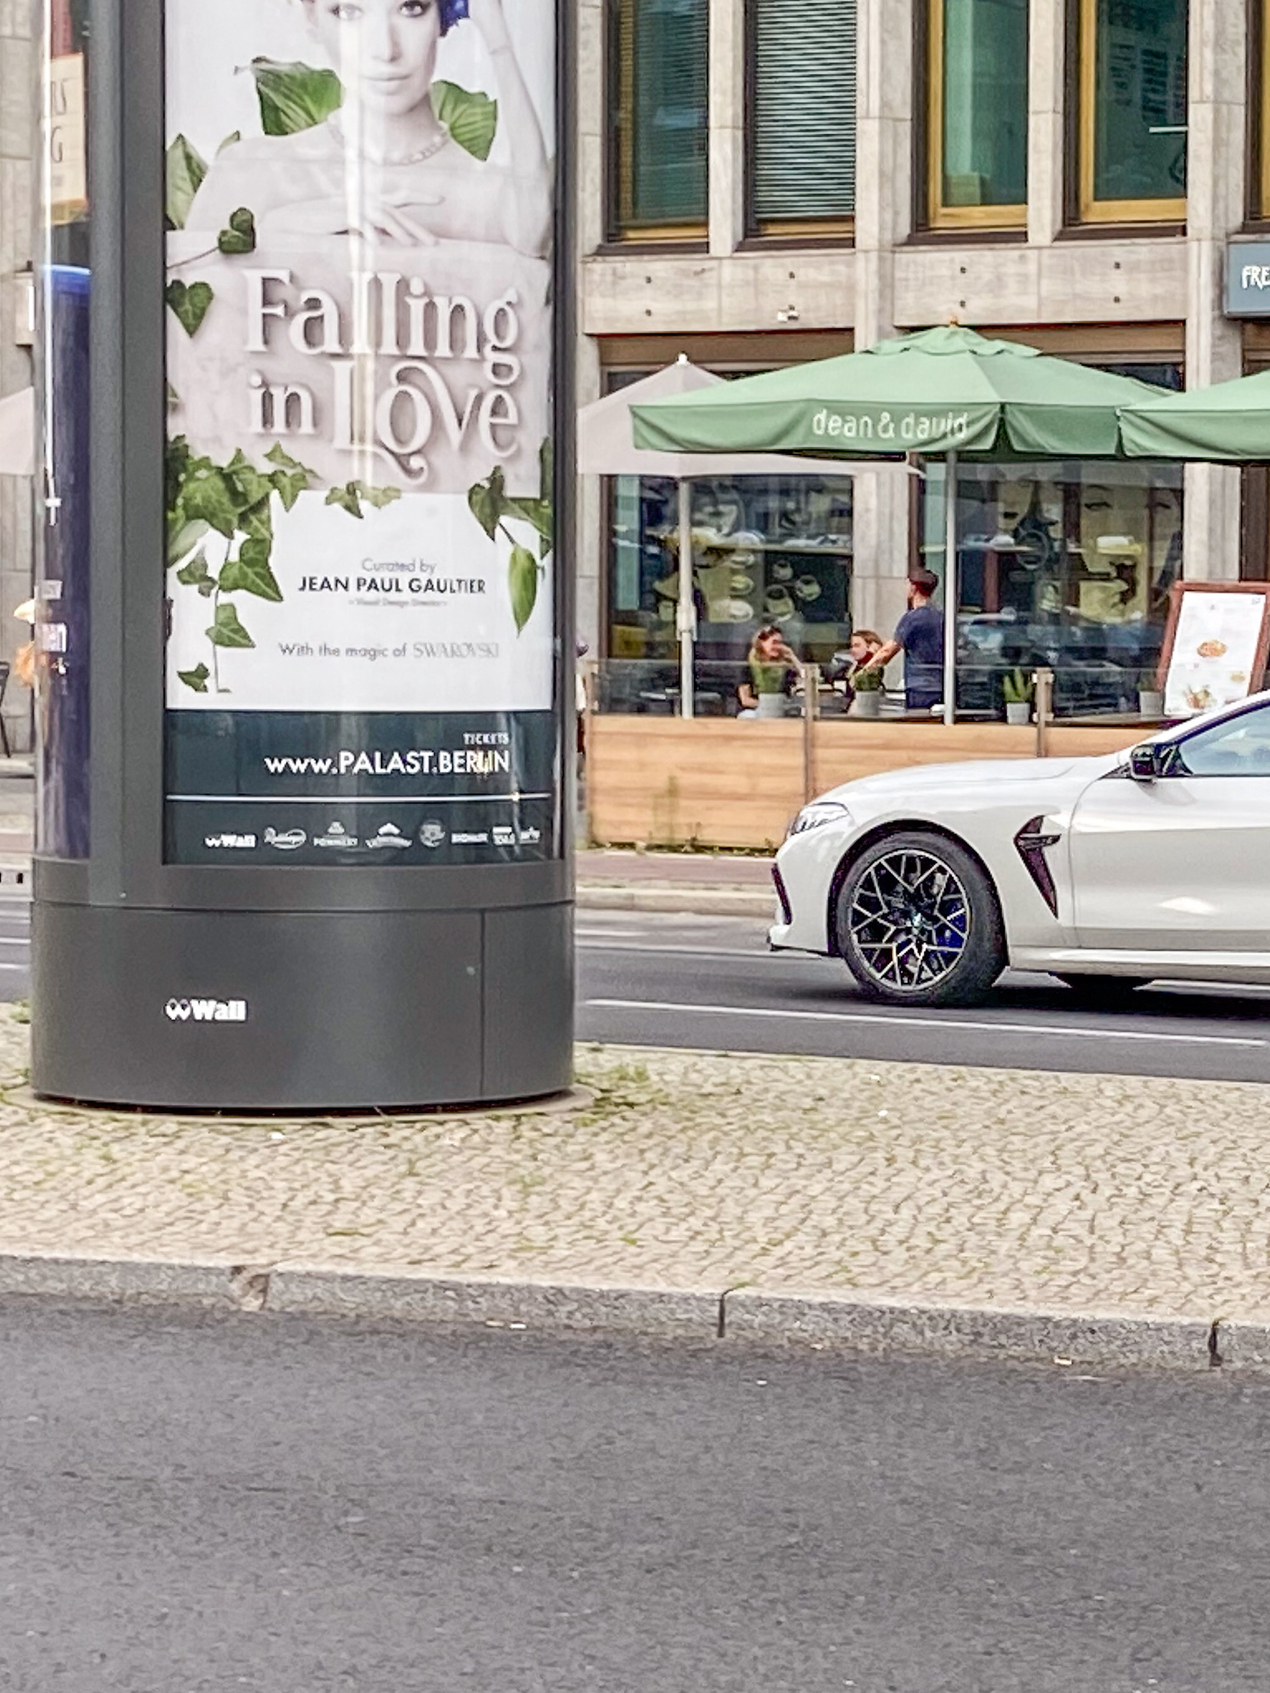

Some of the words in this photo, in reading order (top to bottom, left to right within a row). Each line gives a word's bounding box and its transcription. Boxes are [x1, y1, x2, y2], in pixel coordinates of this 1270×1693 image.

[243, 268, 521, 386] Falling
[250, 369, 316, 435] in
[812, 408, 873, 439] dean
[877, 411, 896, 440] &
[901, 412, 969, 440] david
[361, 558, 415, 573] Curated
[419, 558, 437, 574] by
[298, 576, 350, 593] JEAN
[356, 577, 404, 593] PAUL
[408, 578, 486, 594] GAULTIER
[278, 642, 314, 657] With
[318, 642, 340, 657] the
[345, 643, 389, 661] magic
[392, 643, 407, 658] of
[463, 732, 509, 745] TICKETS
[264, 750, 510, 776] www.PALAST.BERLIN
[190, 999, 246, 1021] Wall
